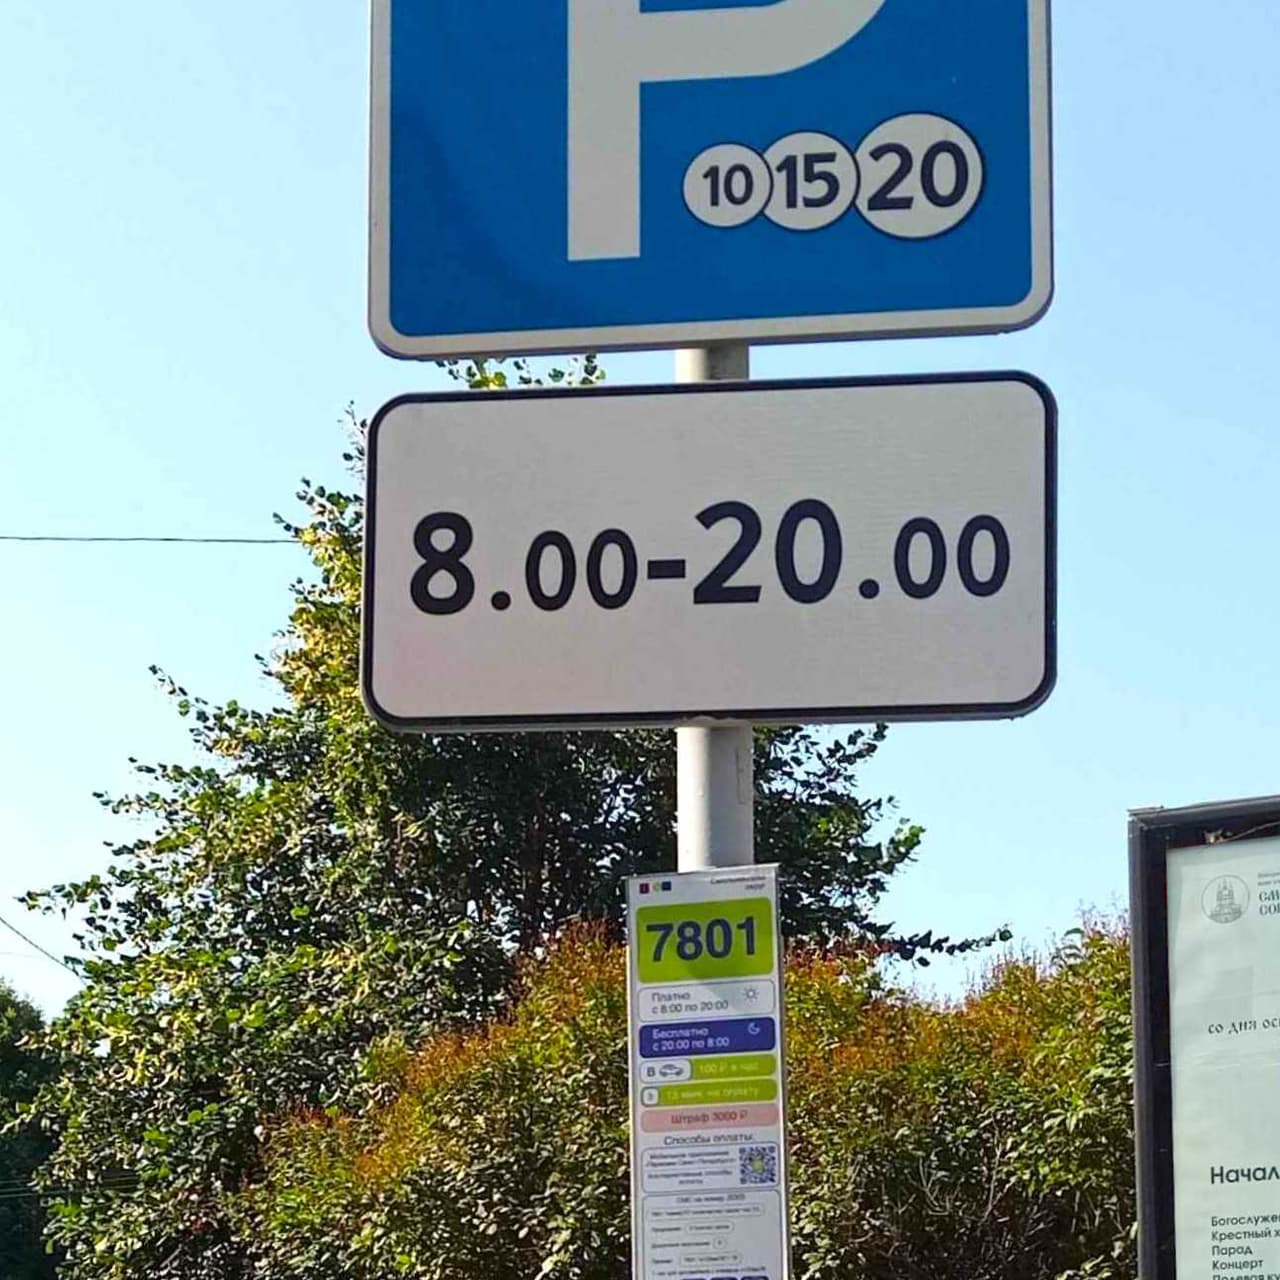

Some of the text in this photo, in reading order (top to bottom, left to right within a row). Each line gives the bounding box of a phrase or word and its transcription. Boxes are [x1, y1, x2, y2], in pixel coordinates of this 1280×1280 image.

[702, 140, 969, 211] 10 15 20
[409, 498, 1011, 615] 8.00-20.00
[645, 915, 757, 963] 7801
[651, 992, 690, 1001] Платно
[1207, 1023, 1224, 1035] со
[1228, 1019, 1257, 1035] дня
[652, 1028, 709, 1039] Бесплатно
[671, 1112, 709, 1124] Штраф
[663, 1134, 711, 1146] Способы
[1210, 1227, 1272, 1242] Крестный
[1211, 1245, 1253, 1256] Парад
[1212, 1259, 1264, 1271] Концерт
